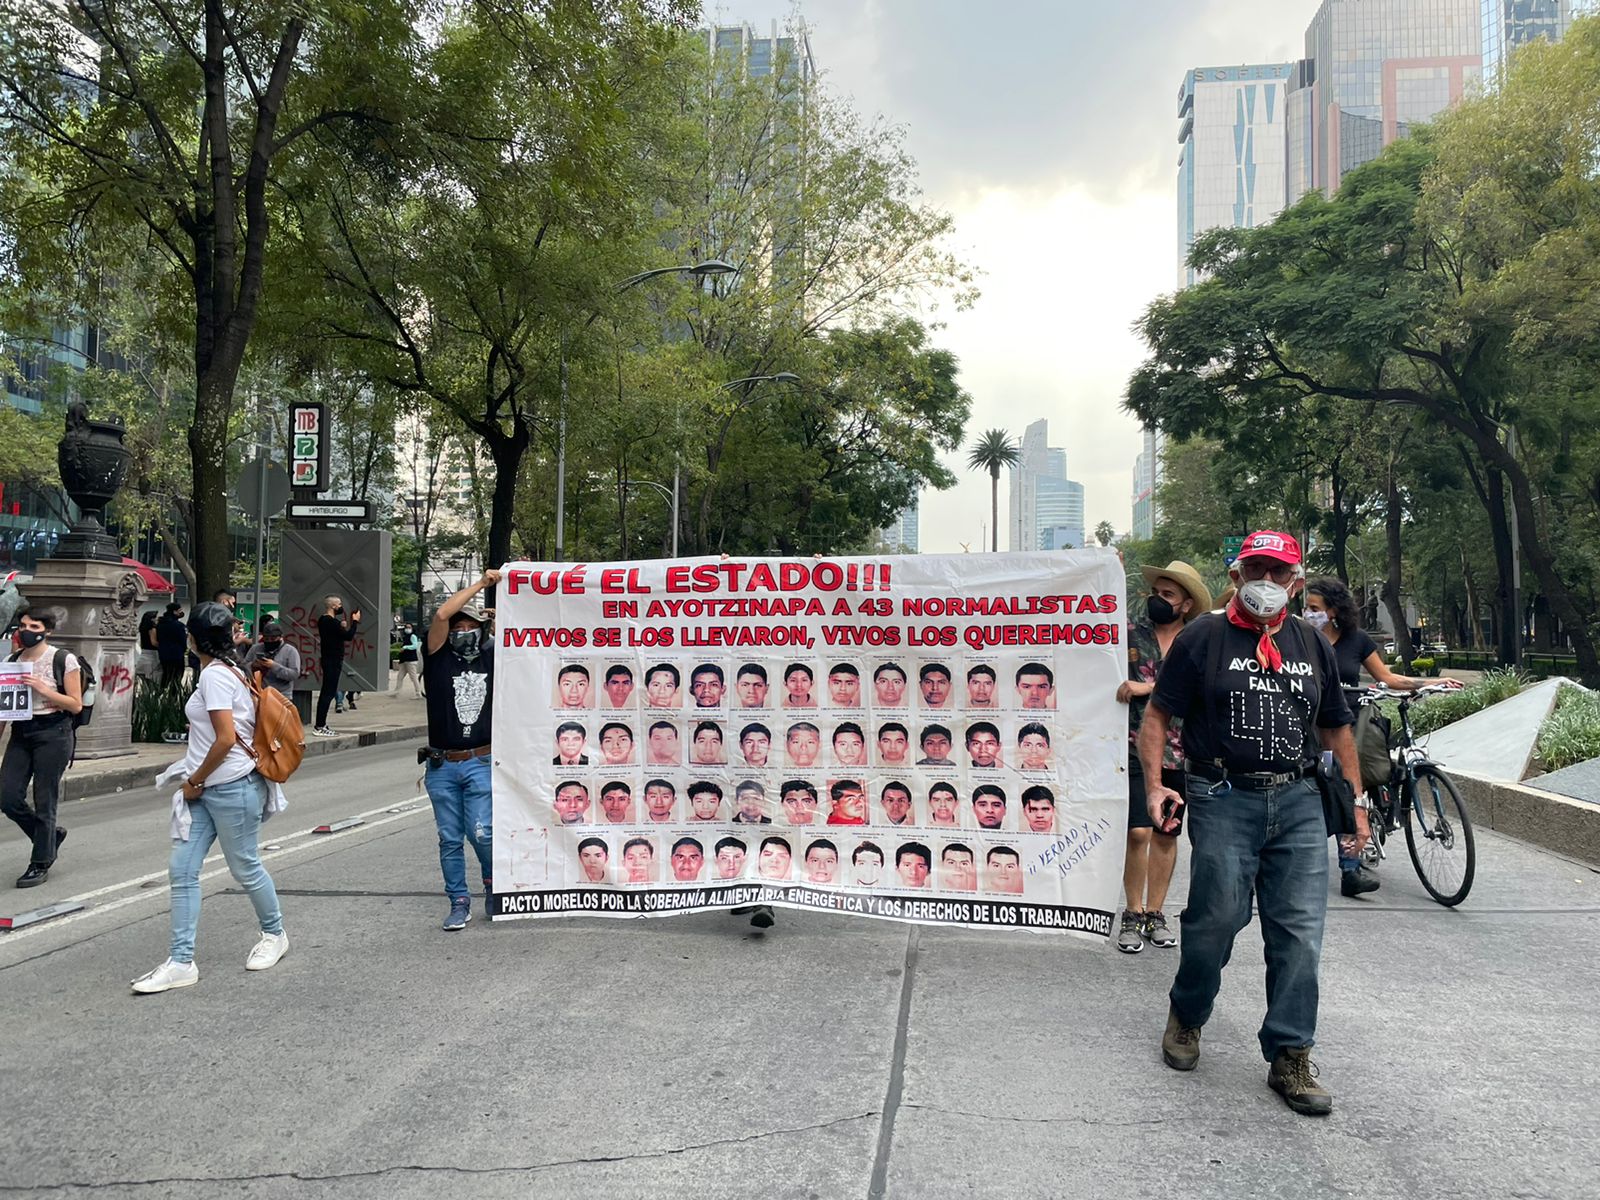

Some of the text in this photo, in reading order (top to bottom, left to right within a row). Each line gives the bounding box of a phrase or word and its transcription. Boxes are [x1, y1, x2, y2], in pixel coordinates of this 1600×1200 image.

[308, 507, 349, 515] HAMBURGO
[1253, 538, 1281, 548] OPT
[507, 562, 892, 595] FUÉ EL ESTADO!!!
[291, 604, 318, 629] 26
[603, 595, 1117, 618] EN AYOTZINAPA A 43 NORMALISTAS
[503, 624, 1119, 649] ¡VIVOS SE LOS LLEVARON, VIVOS LOS QUEREMOS!
[1231, 691, 1311, 760] 43
[1059, 832, 1103, 879] JUSTICIA
[502, 895, 541, 913] PACTO
[544, 892, 599, 910] MORELOS
[602, 893, 625, 910] POR
[627, 893, 642, 911] LA
[644, 889, 706, 911] SOBERANÍA
[708, 888, 785, 906] ALIMENTARIA
[788, 888, 863, 912] ENERGÉTICA
[865, 898, 877, 914] Y
[878, 899, 902, 916] LOS
[904, 902, 970, 921] DERECHOS
[973, 904, 990, 922] DE
[992, 906, 1017, 924] LOS
[1019, 907, 1111, 934] TRABAJADORES
